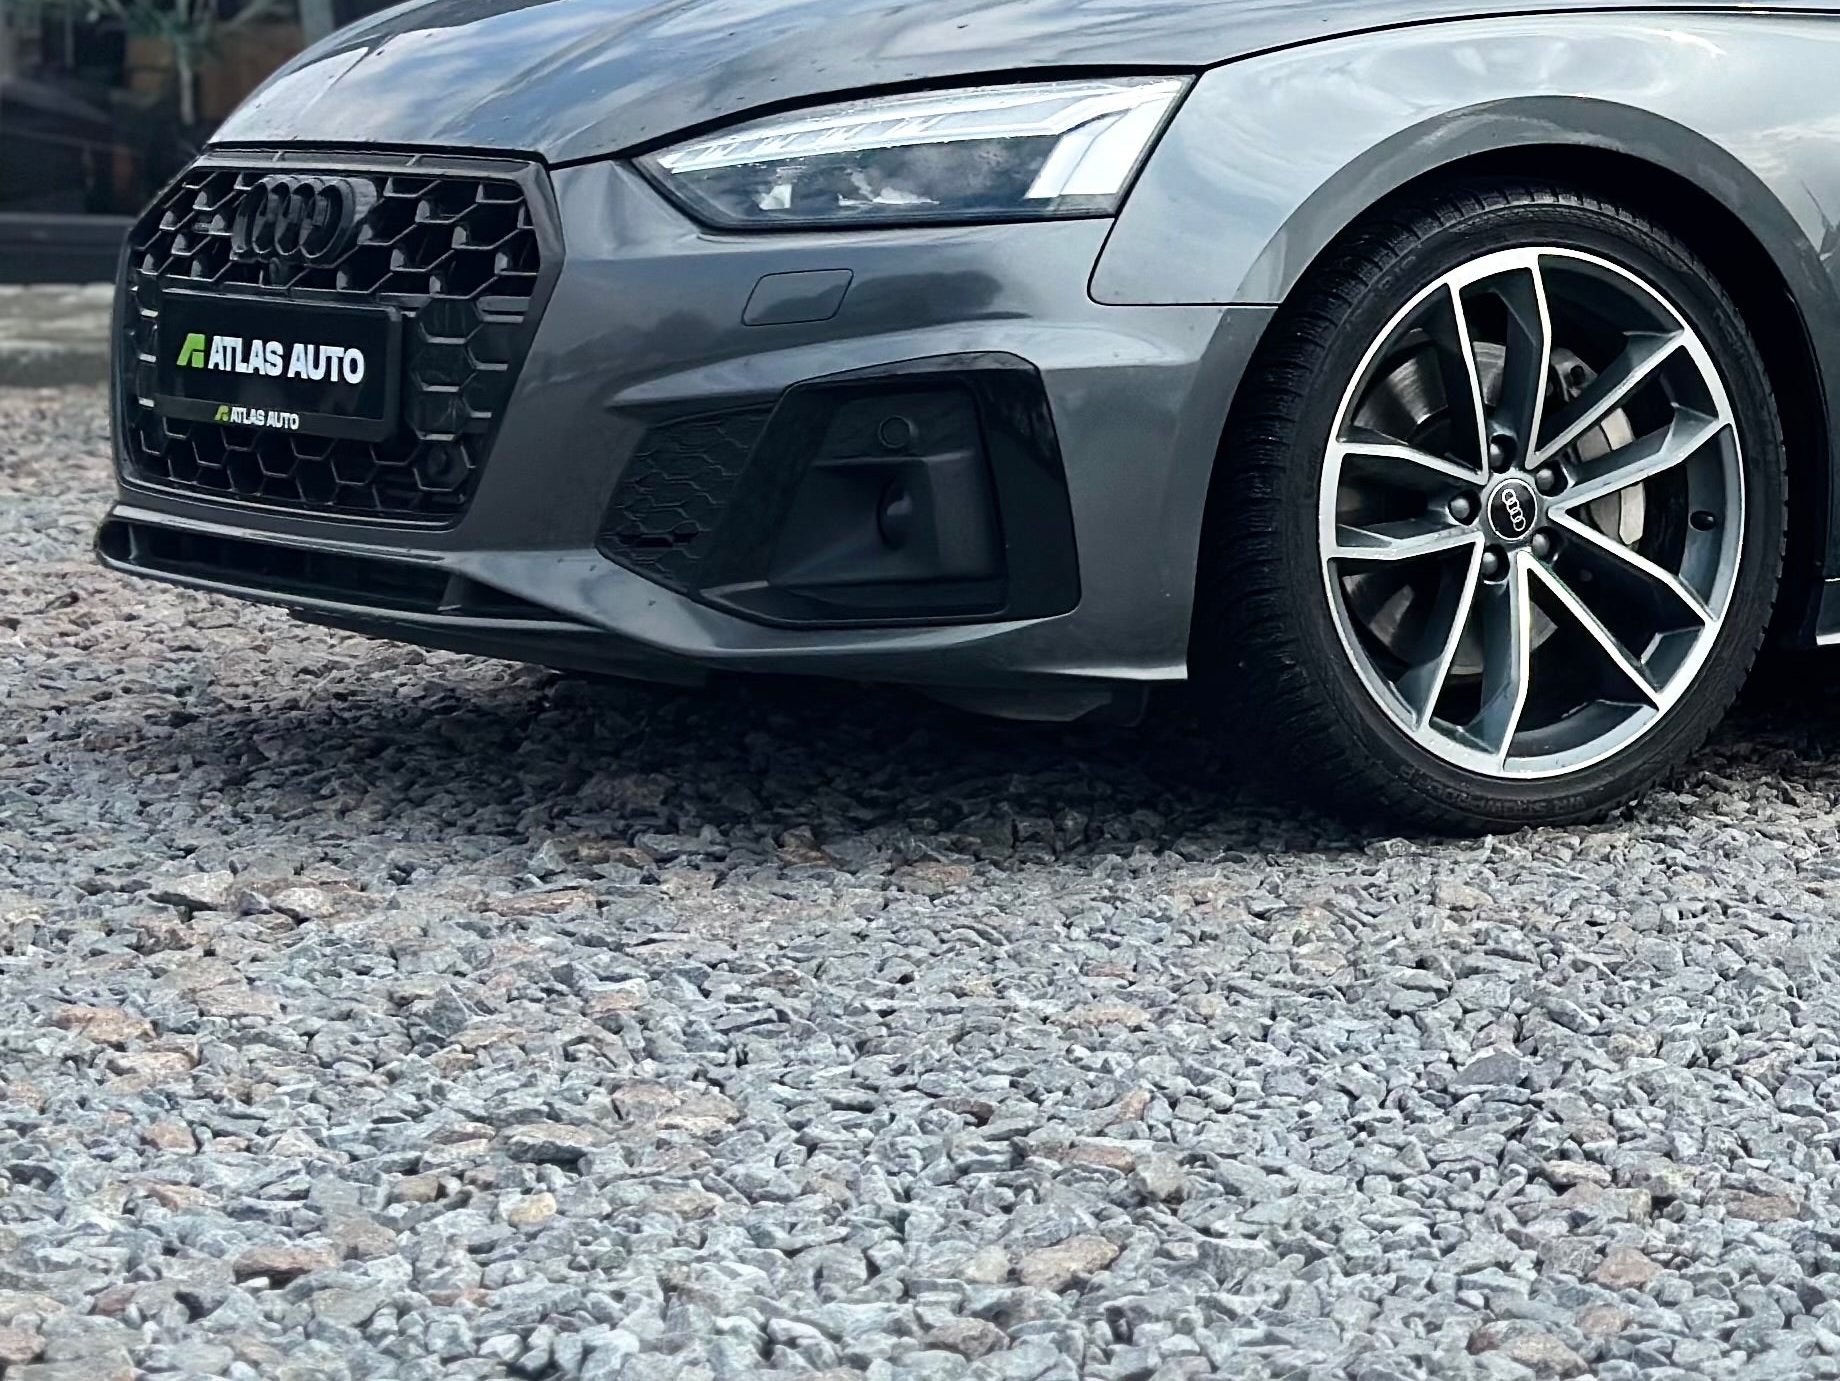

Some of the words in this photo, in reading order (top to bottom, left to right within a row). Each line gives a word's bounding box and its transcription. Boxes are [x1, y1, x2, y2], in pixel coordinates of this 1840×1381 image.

[207, 335, 284, 377] ATLAS
[287, 343, 365, 384] AUTO
[230, 406, 265, 426] ATLAS
[266, 410, 300, 430] AUTO
